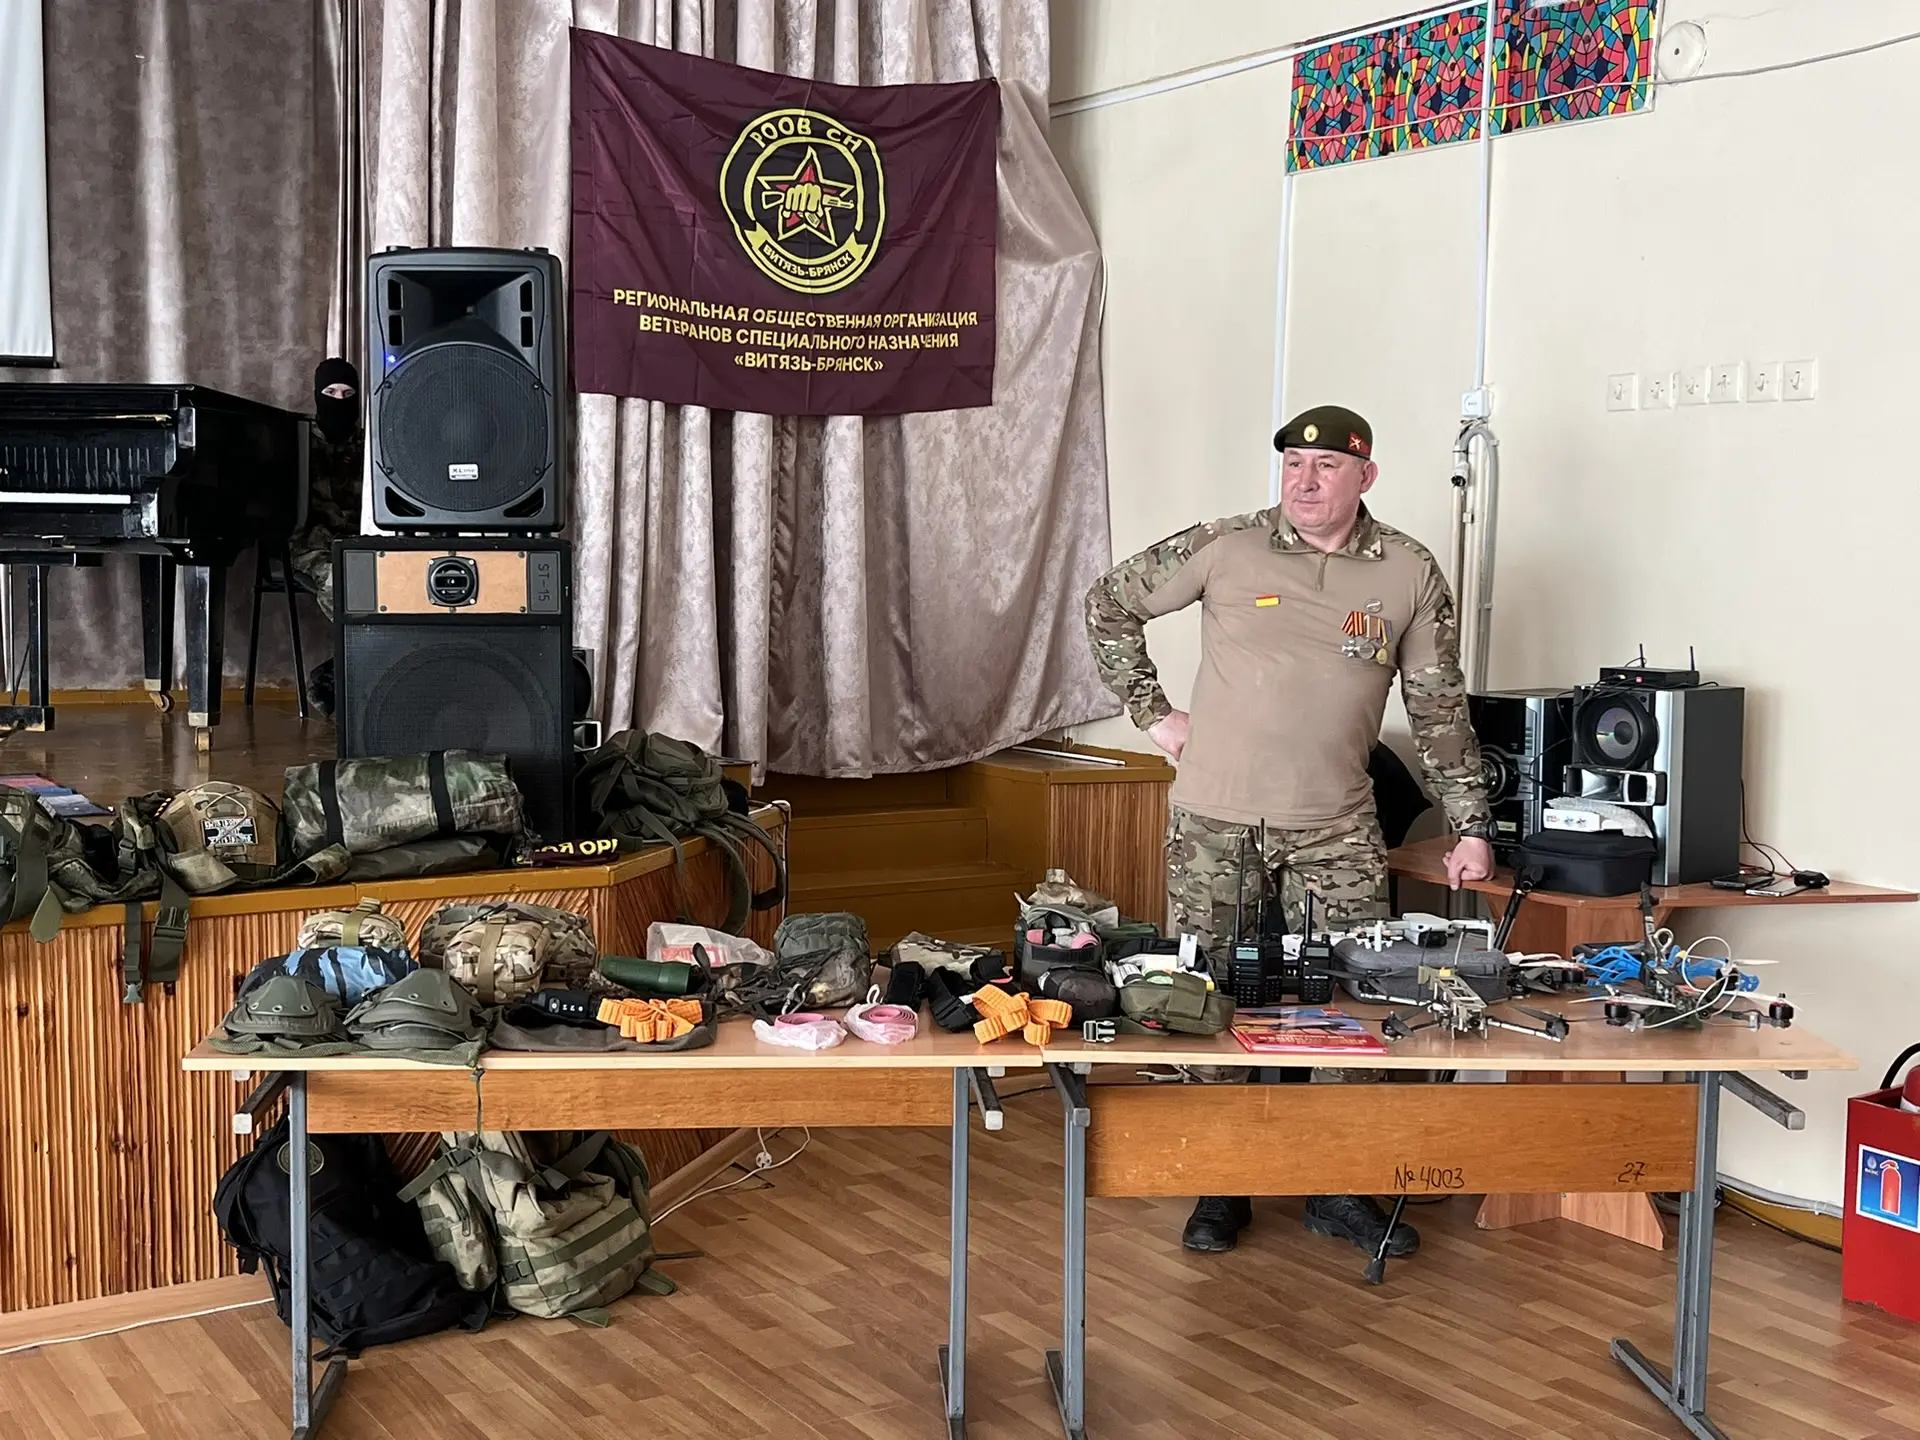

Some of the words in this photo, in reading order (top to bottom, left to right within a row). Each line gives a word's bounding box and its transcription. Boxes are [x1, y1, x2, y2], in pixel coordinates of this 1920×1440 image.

[749, 116, 812, 149] РООВ
[826, 128, 863, 153] СН
[762, 244, 853, 278] ВИТЯЗЬ-БРЯНСК
[613, 288, 750, 323] РЕГИОНАЛЬНАЯ
[752, 308, 882, 329] ОБЩЕСТВЕННАЯ
[883, 311, 979, 329] ОРГАНИЗАЦИЯ
[639, 314, 733, 344] ВЕТЕРАНОВ
[735, 329, 866, 351] СПЕЦИАЛЬНОГО
[868, 332, 960, 350] НАЗНАЧЕНИЯ
[733, 351, 884, 372] «ВИТЯЗЬ-БРЯНСК»
[537, 563, 551, 602] ST-15
[1420, 1166, 1465, 1191] 4003
[1617, 1161, 1646, 1183] 27
